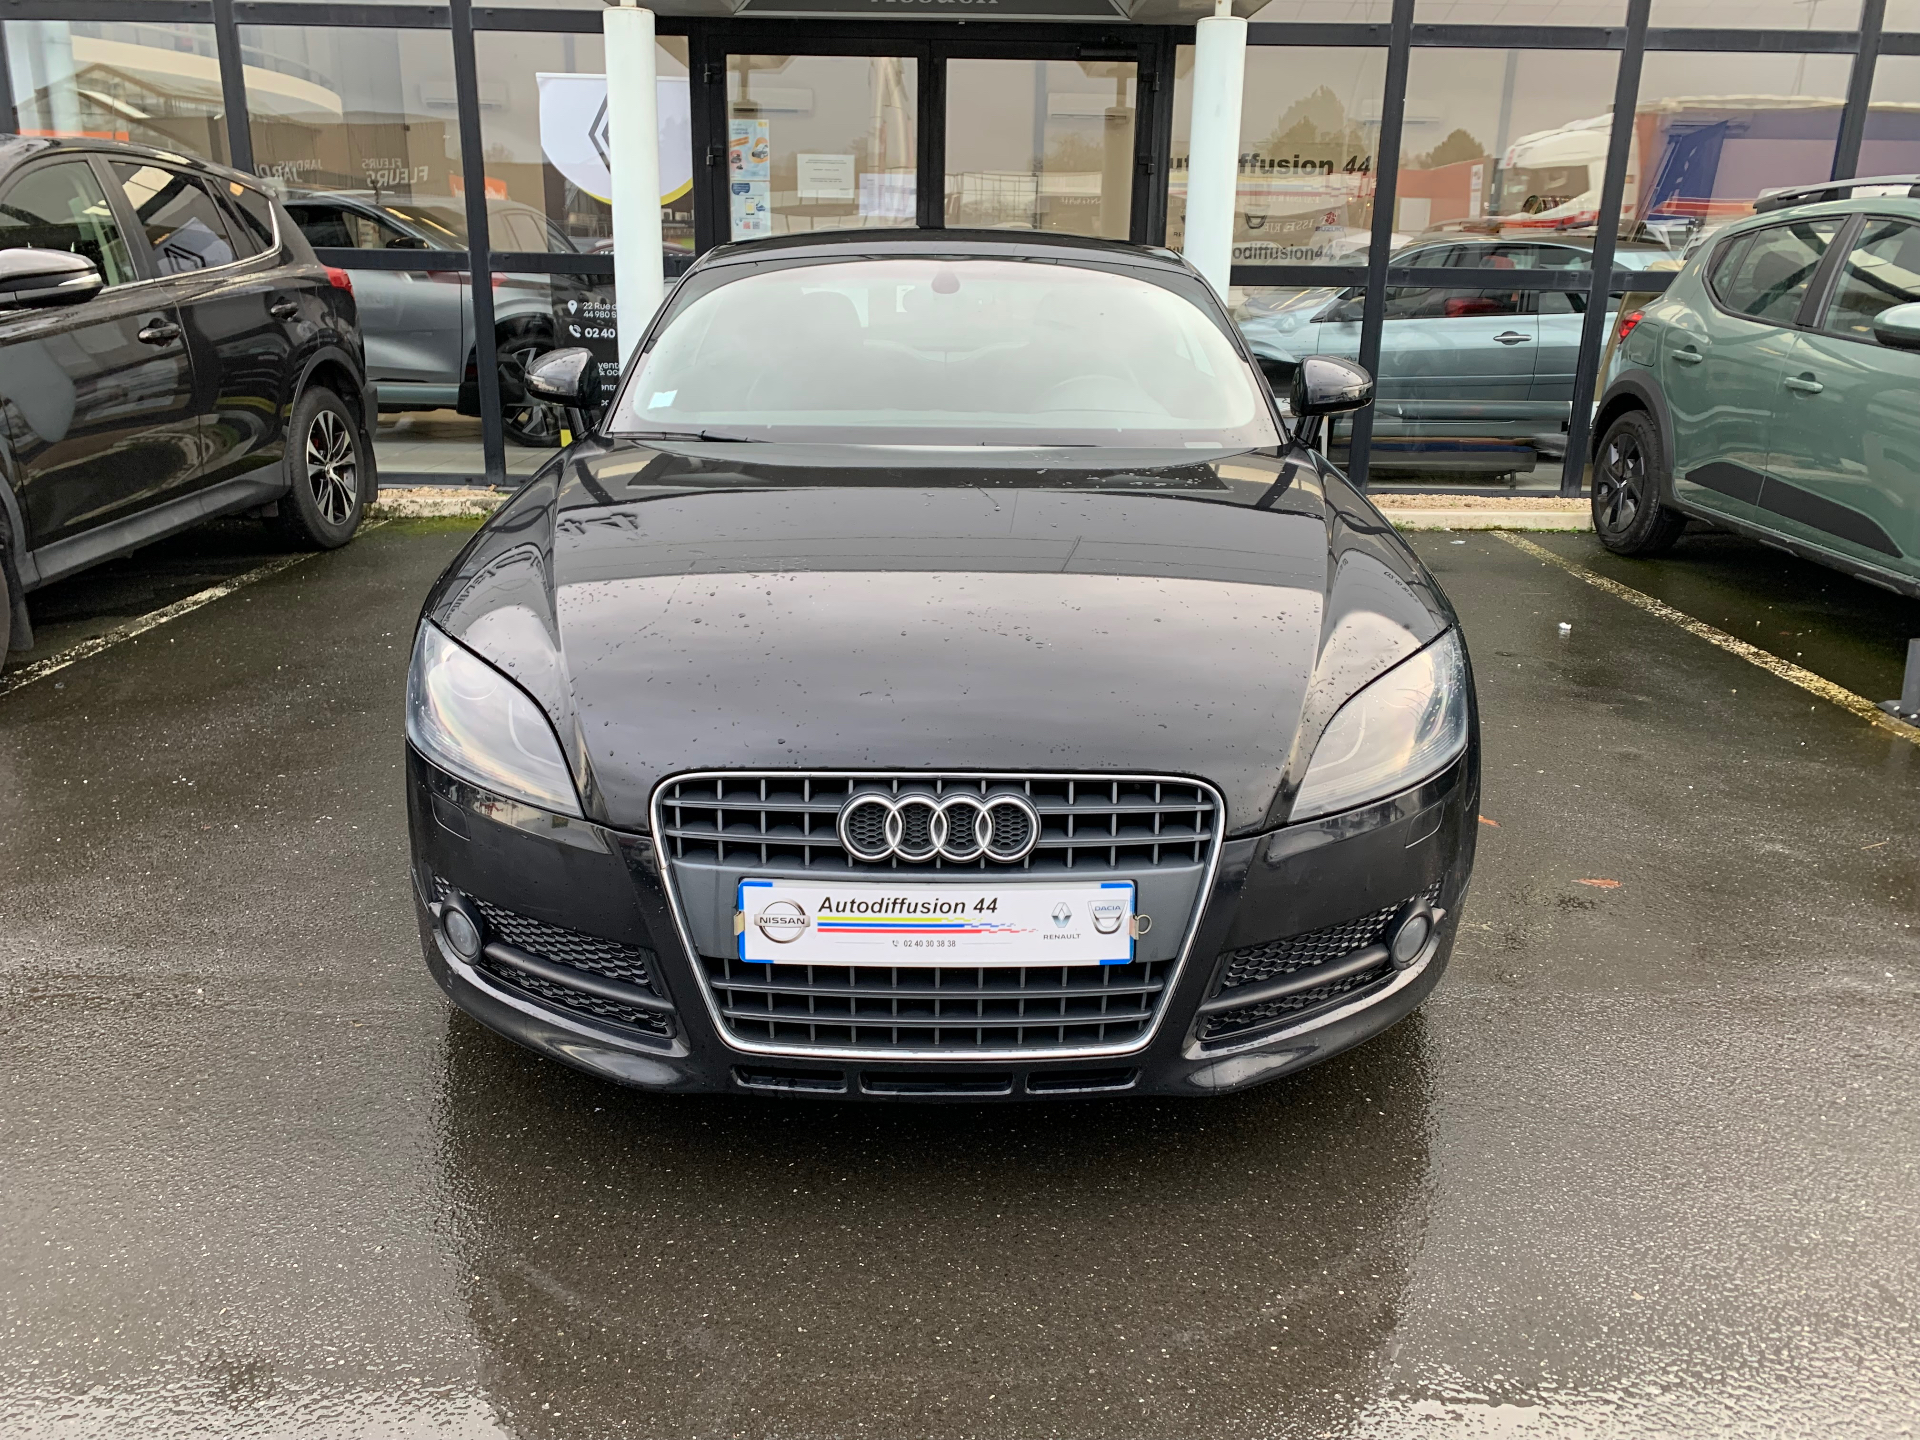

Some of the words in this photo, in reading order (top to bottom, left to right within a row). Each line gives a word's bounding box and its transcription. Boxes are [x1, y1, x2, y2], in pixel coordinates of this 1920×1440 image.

[1342, 154, 1372, 176] 44
[582, 302, 593, 310] 22
[594, 302, 611, 310] Rue
[584, 328, 599, 338] 02
[601, 328, 616, 338] 40
[818, 896, 966, 914] Autodiffusion
[972, 897, 999, 914] 44
[759, 916, 806, 926] NISSAN
[1043, 933, 1082, 941] RENAULT
[903, 939, 913, 948] 02
[914, 939, 924, 948] 40
[925, 939, 935, 948] 30
[936, 939, 946, 948] 38
[947, 939, 957, 948] 38
